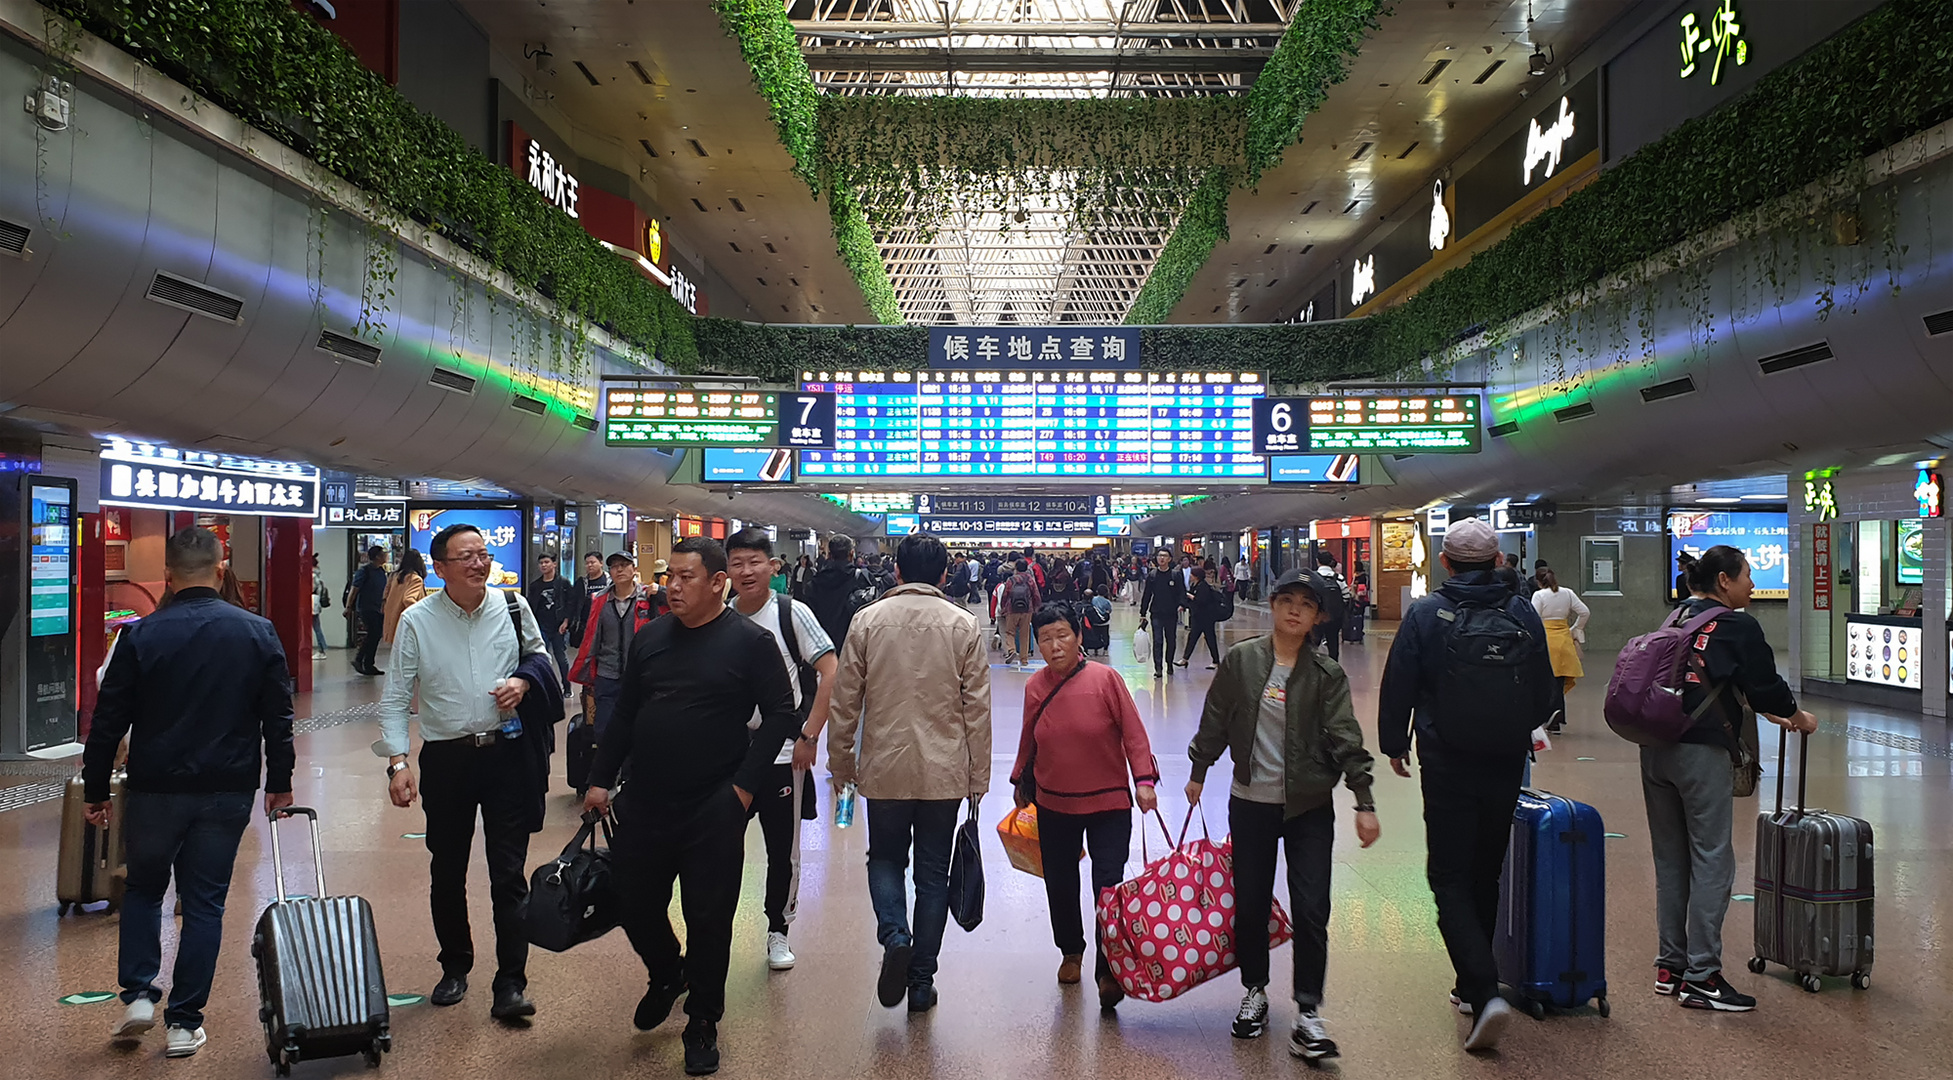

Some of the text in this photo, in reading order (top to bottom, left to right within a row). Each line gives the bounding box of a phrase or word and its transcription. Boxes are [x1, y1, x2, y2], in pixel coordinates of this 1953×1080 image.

[528, 139, 578, 218] 永和大王
[670, 265, 696, 314] 永和大王
[943, 335, 1126, 361] 候车地点查询
[798, 397, 816, 425] 7
[1271, 403, 1292, 432] 6
[1040, 453, 1054, 461] T49
[1063, 453, 1086, 461] 16:20
[1099, 453, 1106, 461] 4
[920, 494, 929, 506] 9
[1028, 502, 1040, 511] 12
[1064, 502, 1076, 511] 10
[1096, 496, 1105, 508] 8
[345, 508, 401, 522] 礼品店
[960, 521, 983, 531] 10-13
[1021, 521, 1031, 531] 12
[1815, 525, 1828, 608] 就餐请上二楼
